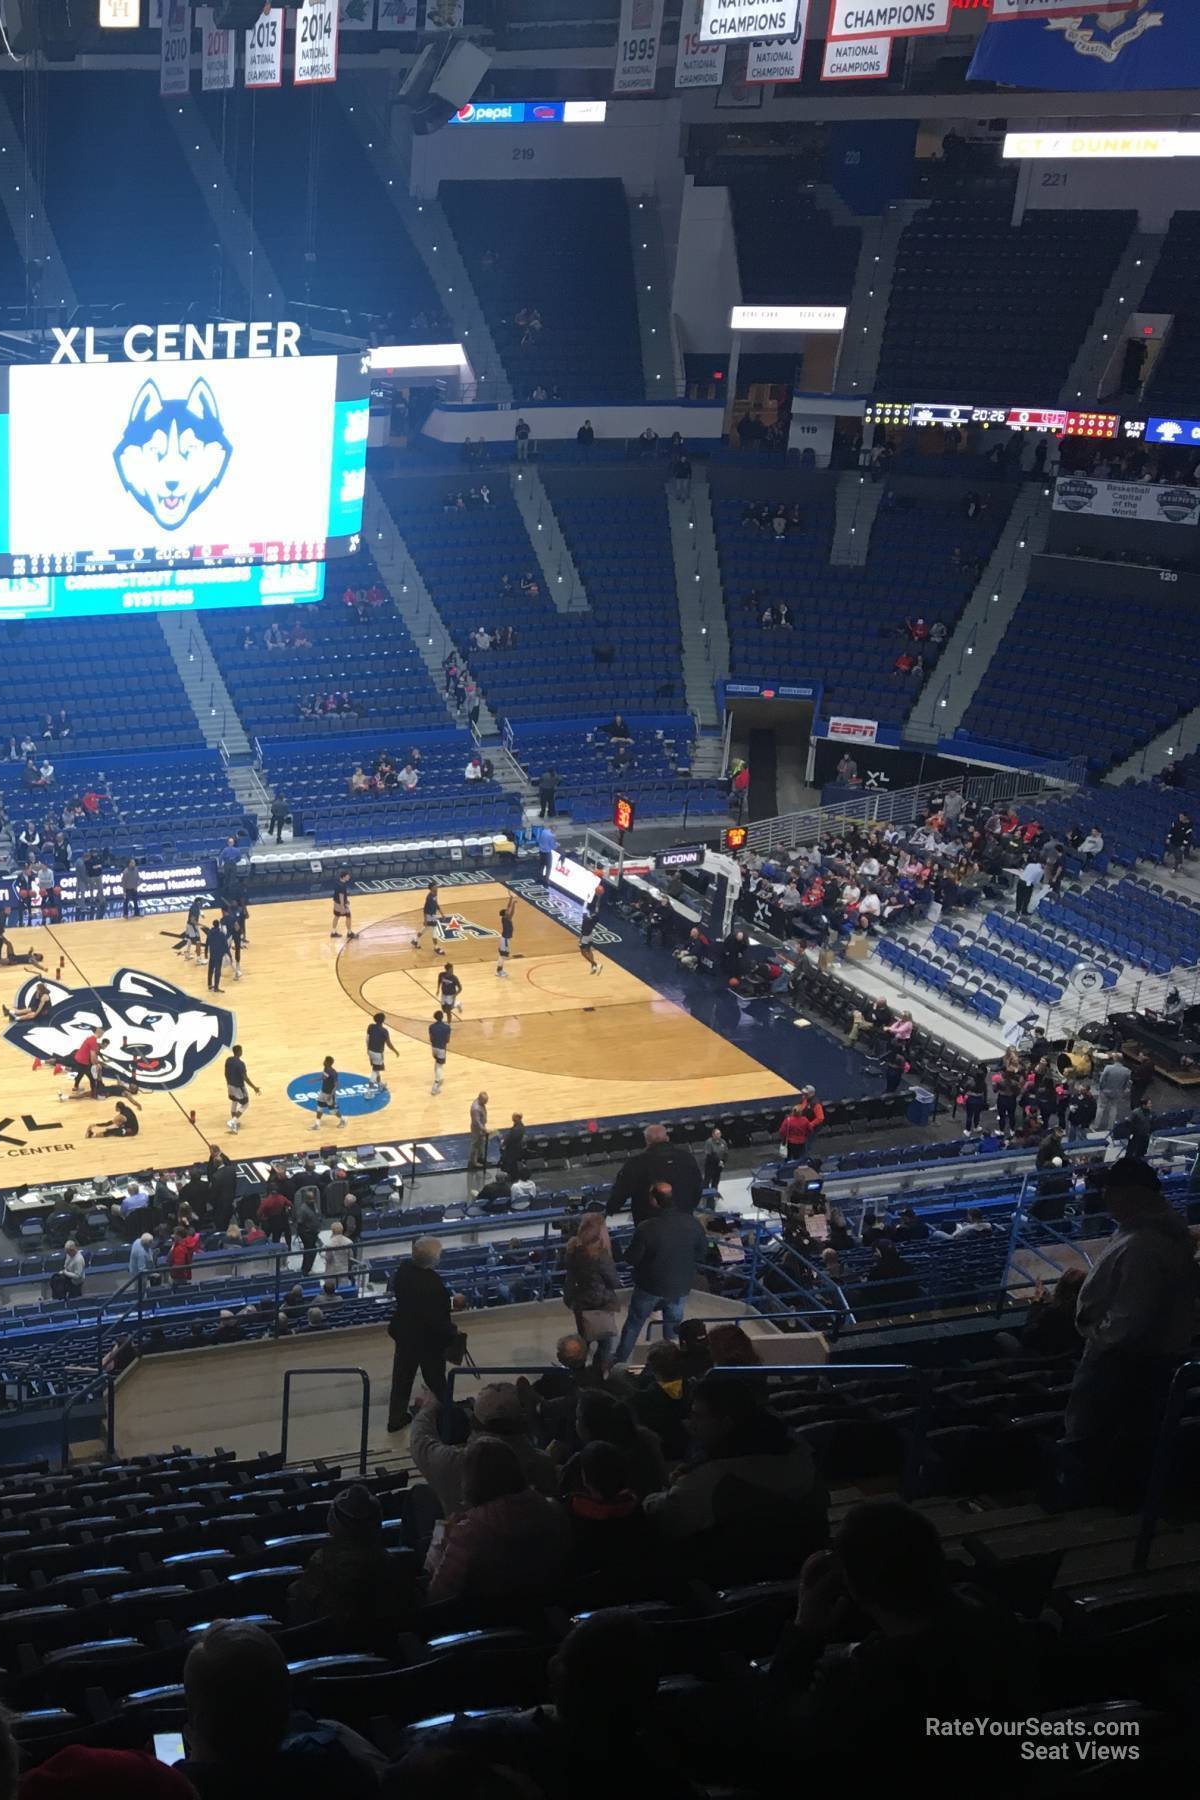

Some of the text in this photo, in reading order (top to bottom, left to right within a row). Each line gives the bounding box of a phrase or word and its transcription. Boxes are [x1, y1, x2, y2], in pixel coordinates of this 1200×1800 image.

[844, 3, 936, 29] CHAMPIONS
[300, 13, 332, 42] 2014
[709, 12, 786, 35] CHAMPIONS
[250, 21, 277, 49] 2013
[301, 47, 329, 59] NATIONAL
[623, 38, 656, 61] 1995
[835, 45, 879, 57] NATIONAL
[756, 51, 793, 61] NATIONAL
[299, 63, 331, 77] CHAMPIONS
[683, 60, 717, 70] NATIONAL
[830, 61, 880, 73] CHAMPIONS
[751, 66, 795, 78] CHAMPIONS
[679, 73, 719, 84] CHAMPIONS
[476, 105, 513, 120] pepsi
[511, 148, 535, 160] 219
[1041, 173, 1068, 186] 221
[50, 321, 302, 364] XL CENTER
[950, 408, 960, 419] 0
[972, 409, 1005, 422] 20:26
[1126, 430, 1140, 438] PM
[1106, 484, 1151, 494] Basketball
[1112, 493, 1142, 502] Capital
[1111, 508, 1137, 517] World
[1160, 571, 1178, 581] 120
[830, 722, 875, 737] ESPN
[866, 770, 889, 786] XL
[663, 853, 697, 865] UCONN
[168, 878, 206, 890] Huskies
[355, 871, 495, 893] UCONN
[7, 1143, 76, 1158] CENTER
